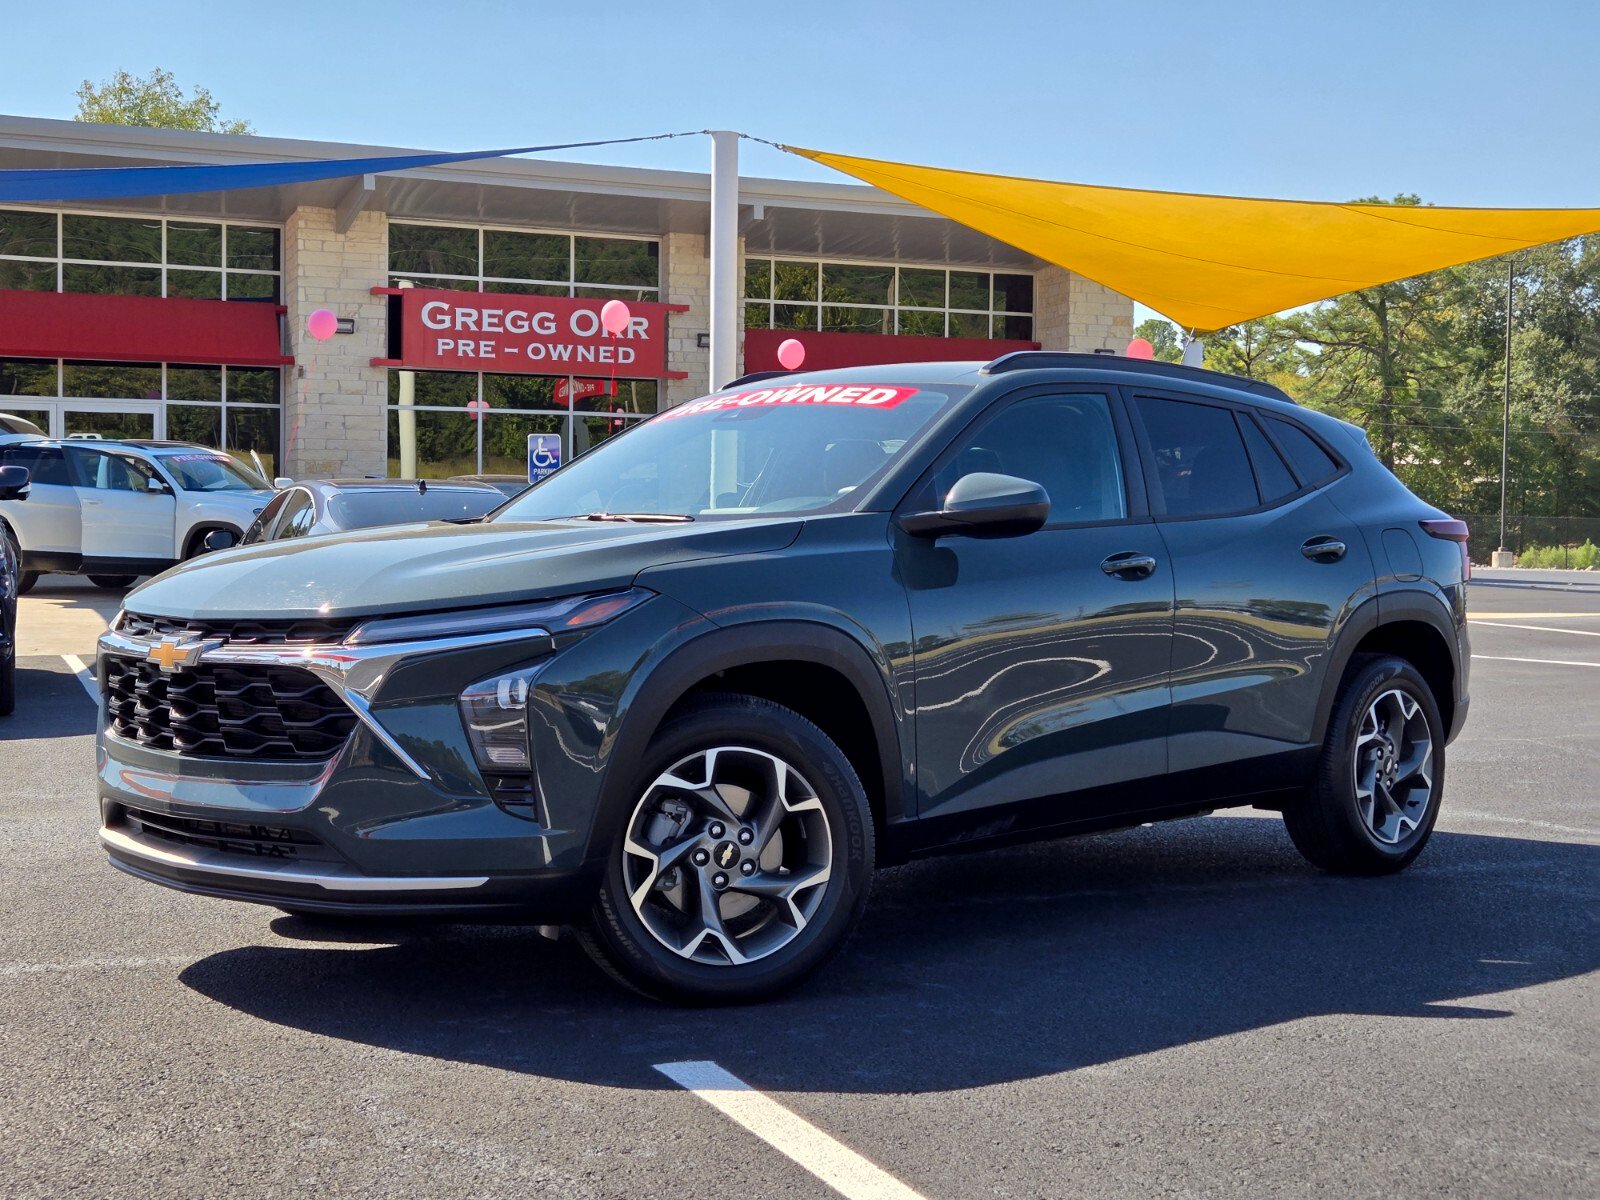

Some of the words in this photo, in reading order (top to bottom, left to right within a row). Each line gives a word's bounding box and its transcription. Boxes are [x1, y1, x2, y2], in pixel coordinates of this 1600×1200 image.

[421, 301, 557, 335] GREGG
[569, 309, 650, 340] OR
[437, 338, 496, 358] PRE
[527, 342, 635, 364] OWNED
